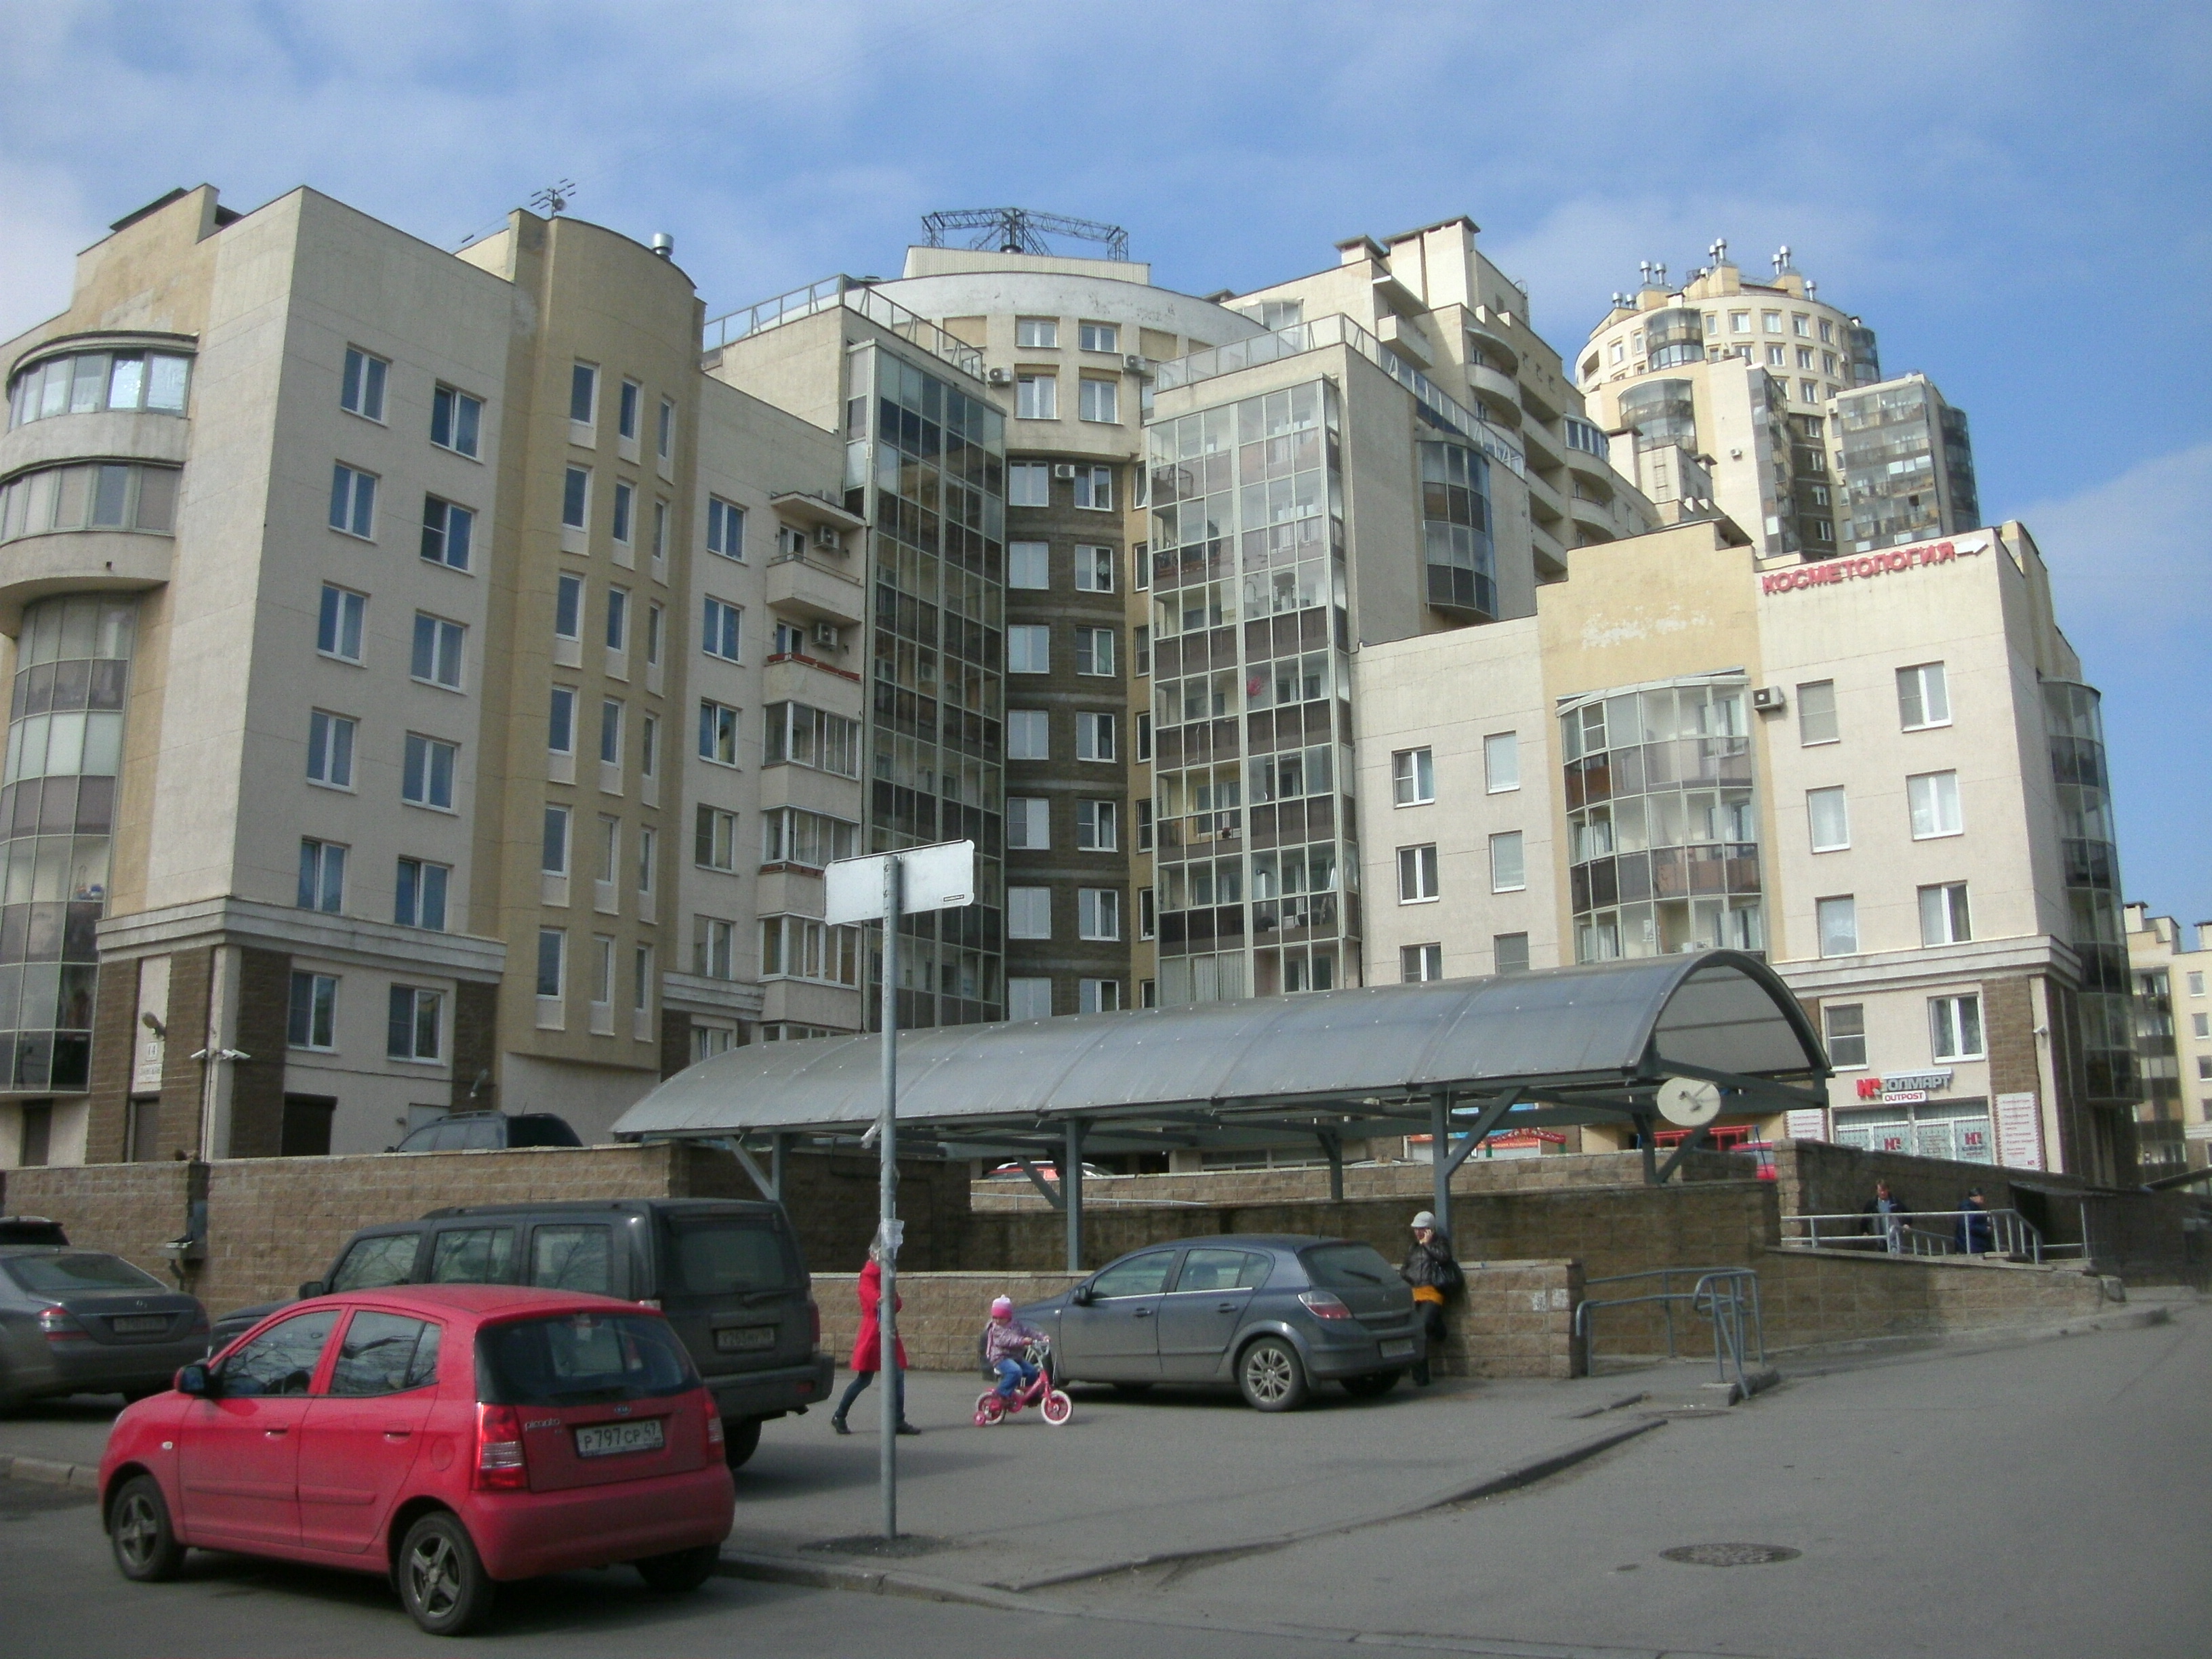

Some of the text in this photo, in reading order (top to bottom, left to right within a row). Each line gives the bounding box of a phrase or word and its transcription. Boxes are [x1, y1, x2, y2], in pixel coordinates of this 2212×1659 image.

[1762, 541, 1955, 594] КОСМЕТОЛОГИЯ
[1883, 1075, 1950, 1092] ЮЛМАРТ
[1885, 1092, 1923, 1101] OUTPOST
